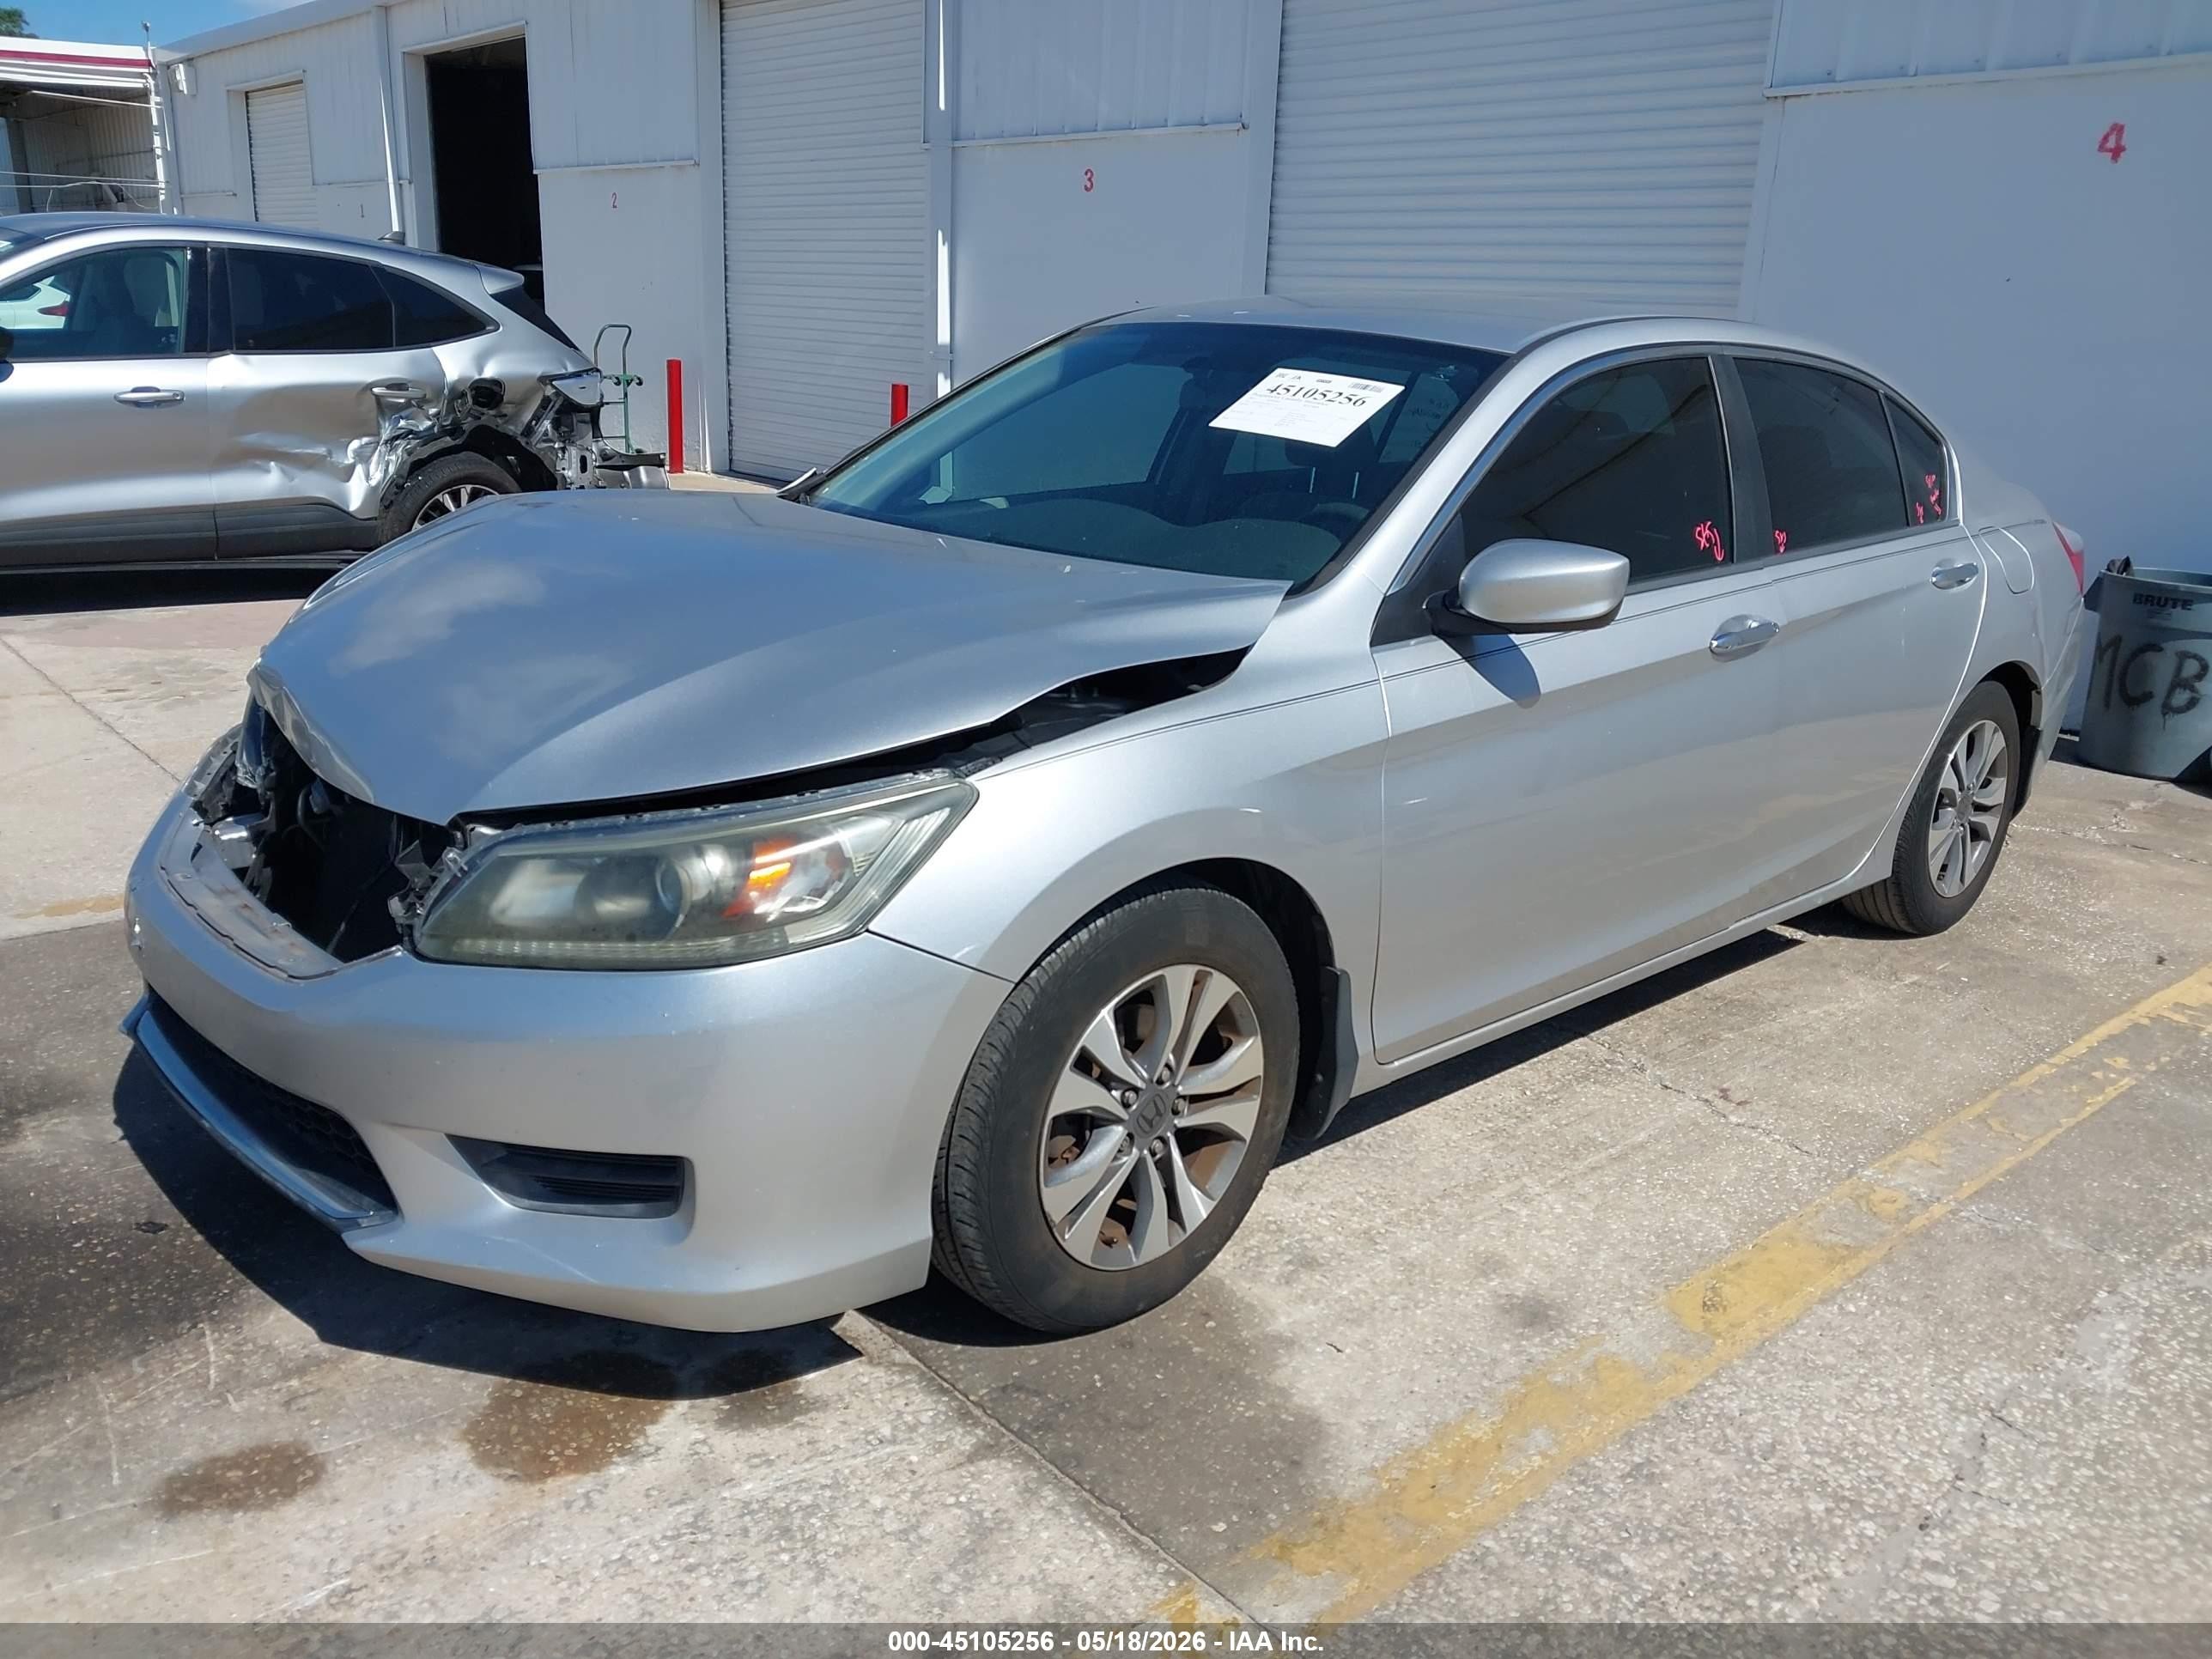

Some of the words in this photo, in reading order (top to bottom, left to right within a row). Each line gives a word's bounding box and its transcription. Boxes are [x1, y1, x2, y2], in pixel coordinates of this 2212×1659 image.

[2097, 123, 2126, 164] 4
[1084, 168, 1094, 192] 3
[611, 191, 617, 209] 2
[1266, 383, 1369, 407] 45105256
[2132, 592, 2194, 611] BRUTE
